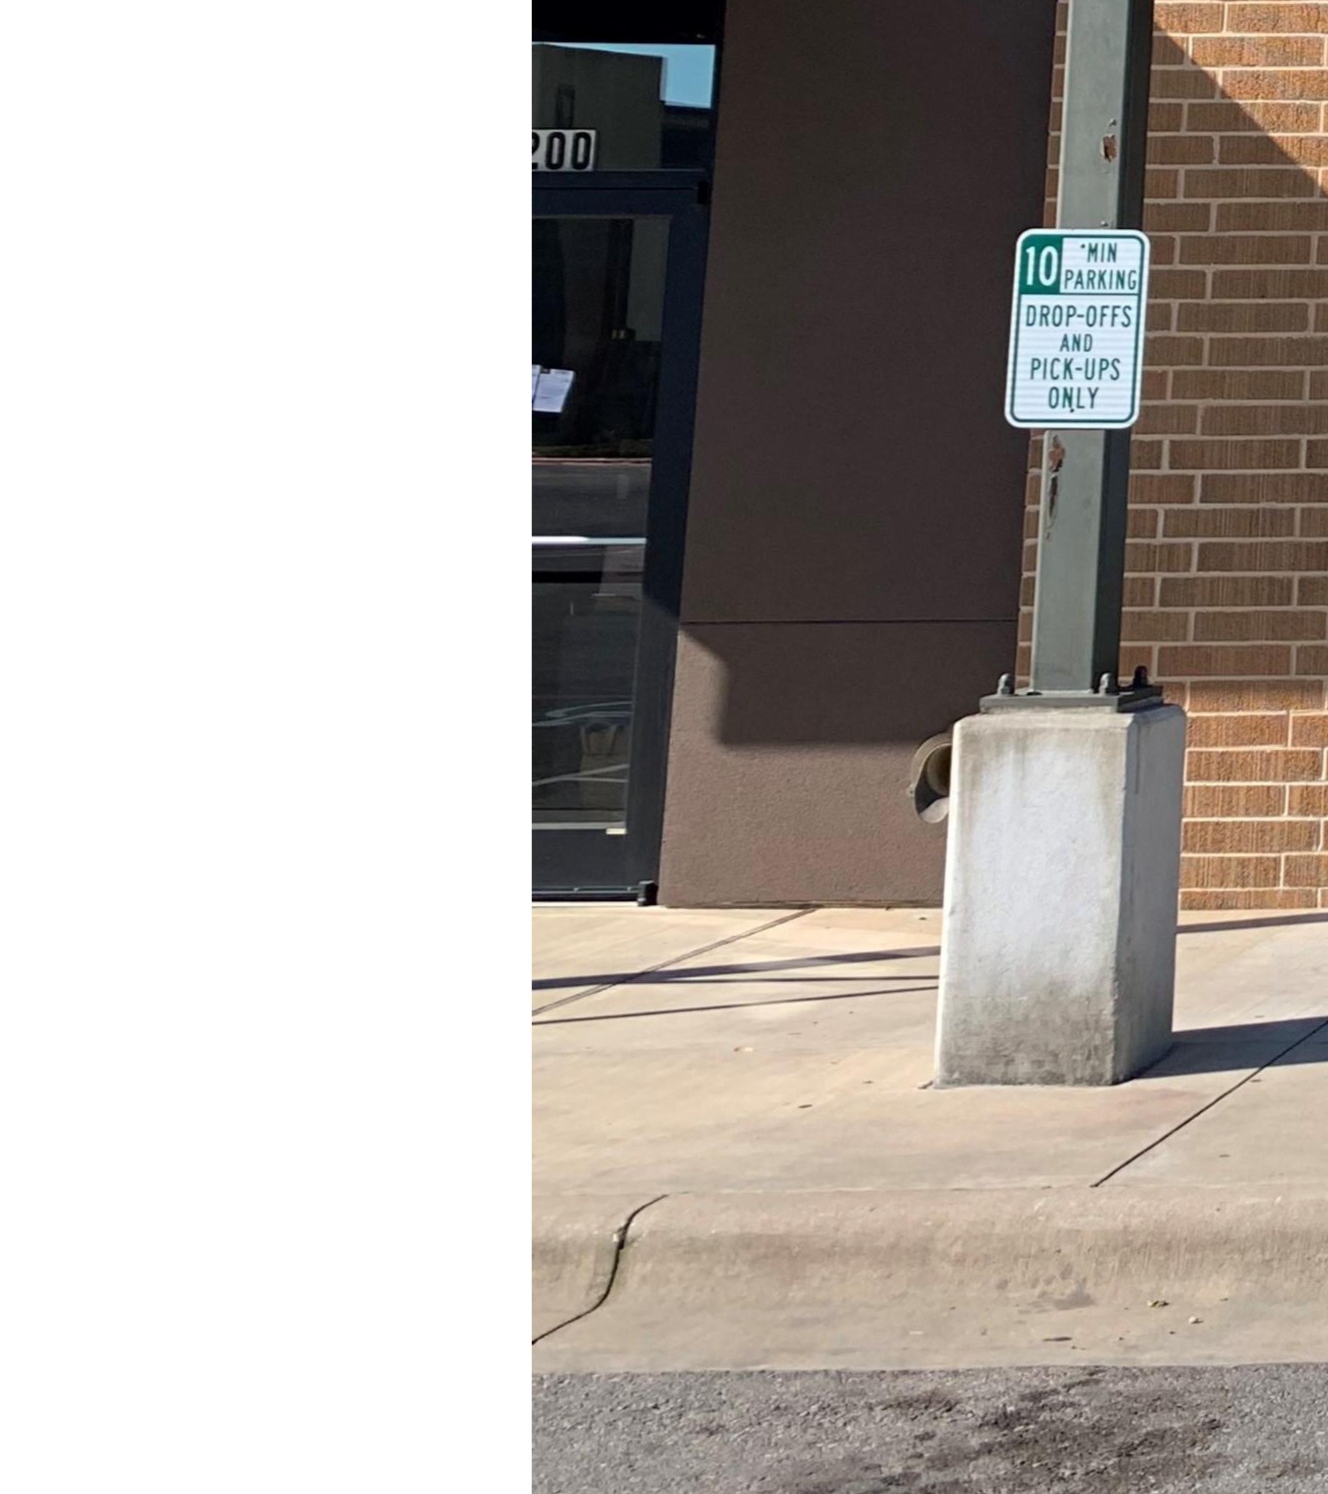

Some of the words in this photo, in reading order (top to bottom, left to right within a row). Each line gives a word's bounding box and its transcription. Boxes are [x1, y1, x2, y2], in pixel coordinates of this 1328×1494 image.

[1024, 245, 1057, 286] 10
[1086, 242, 1119, 264] MIN
[1063, 268, 1138, 291] PARKING
[1025, 303, 1133, 329] DROP-OFFS
[1059, 333, 1094, 353] AND
[1029, 357, 1121, 382] PICK-UPS
[1048, 386, 1100, 411] ONLY
